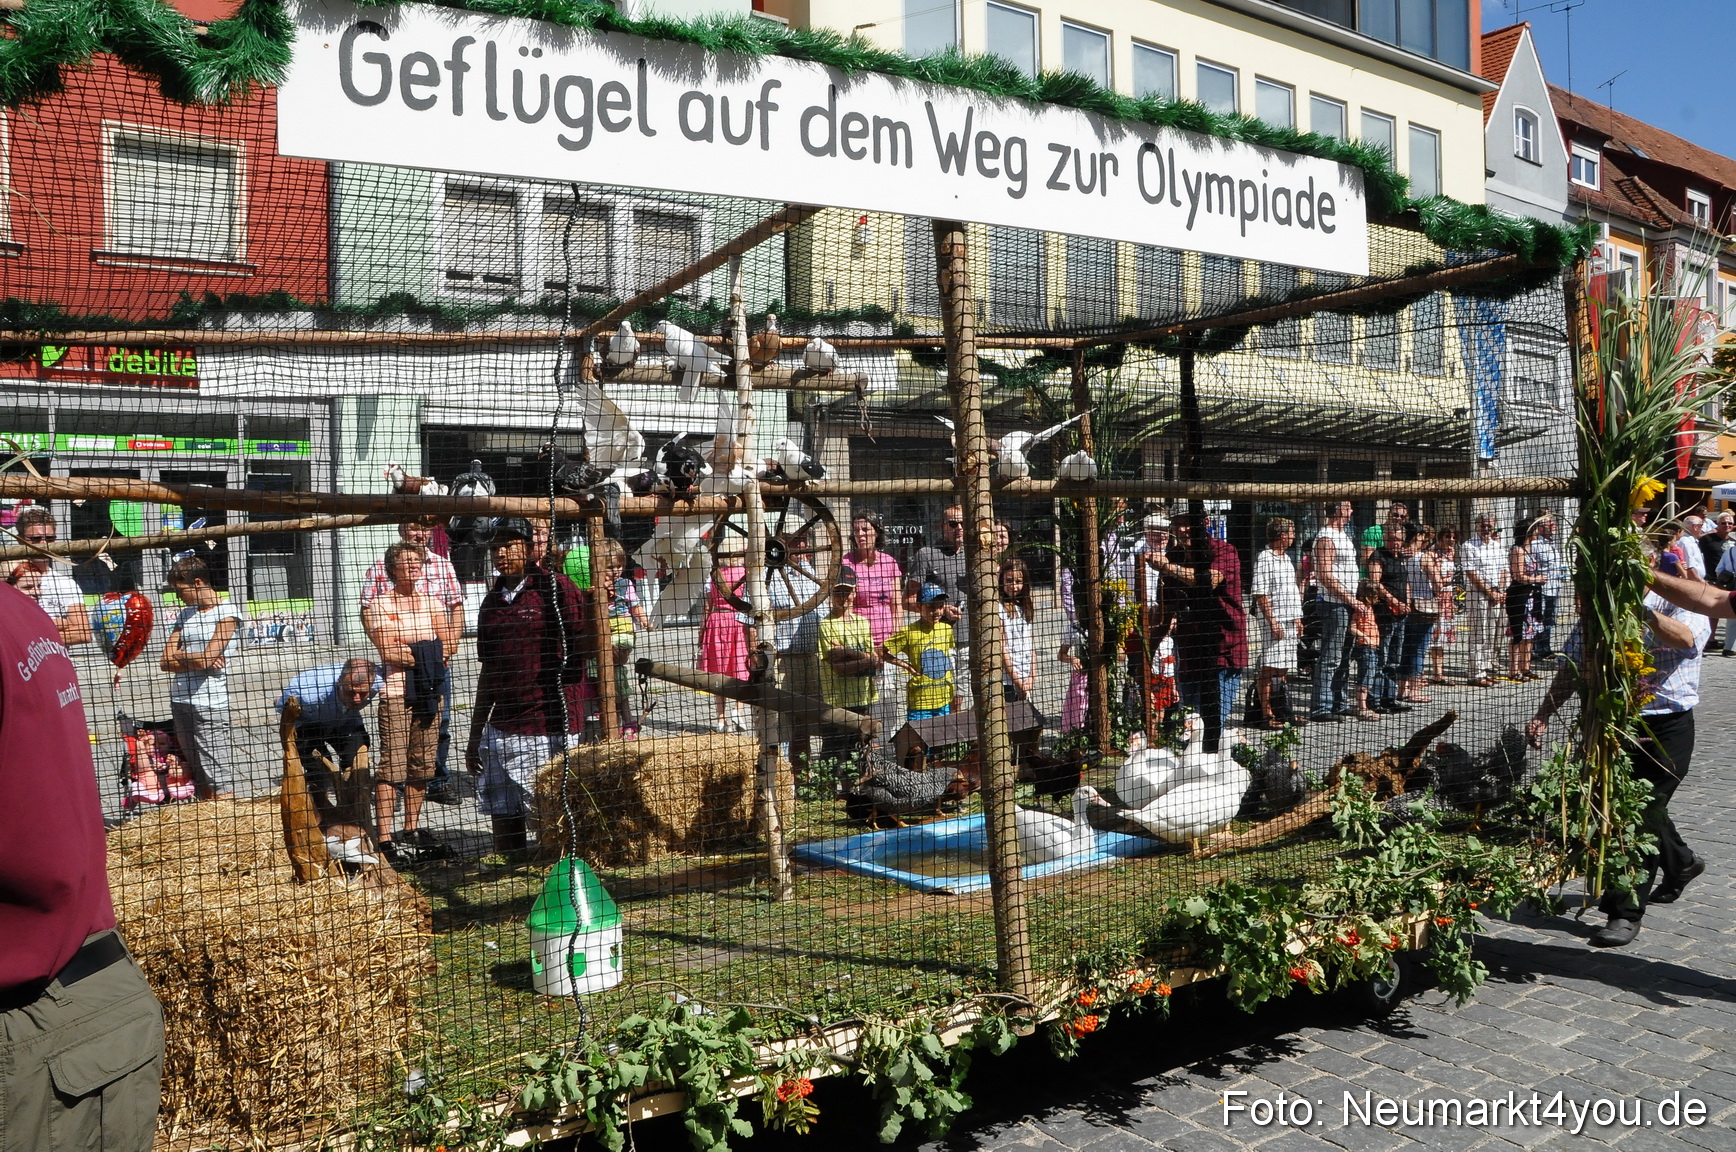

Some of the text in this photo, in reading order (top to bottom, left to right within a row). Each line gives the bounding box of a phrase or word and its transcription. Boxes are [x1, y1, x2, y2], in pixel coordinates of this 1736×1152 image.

[340, 21, 1336, 238] Geflügel auf dem Weg zur Olympiade
